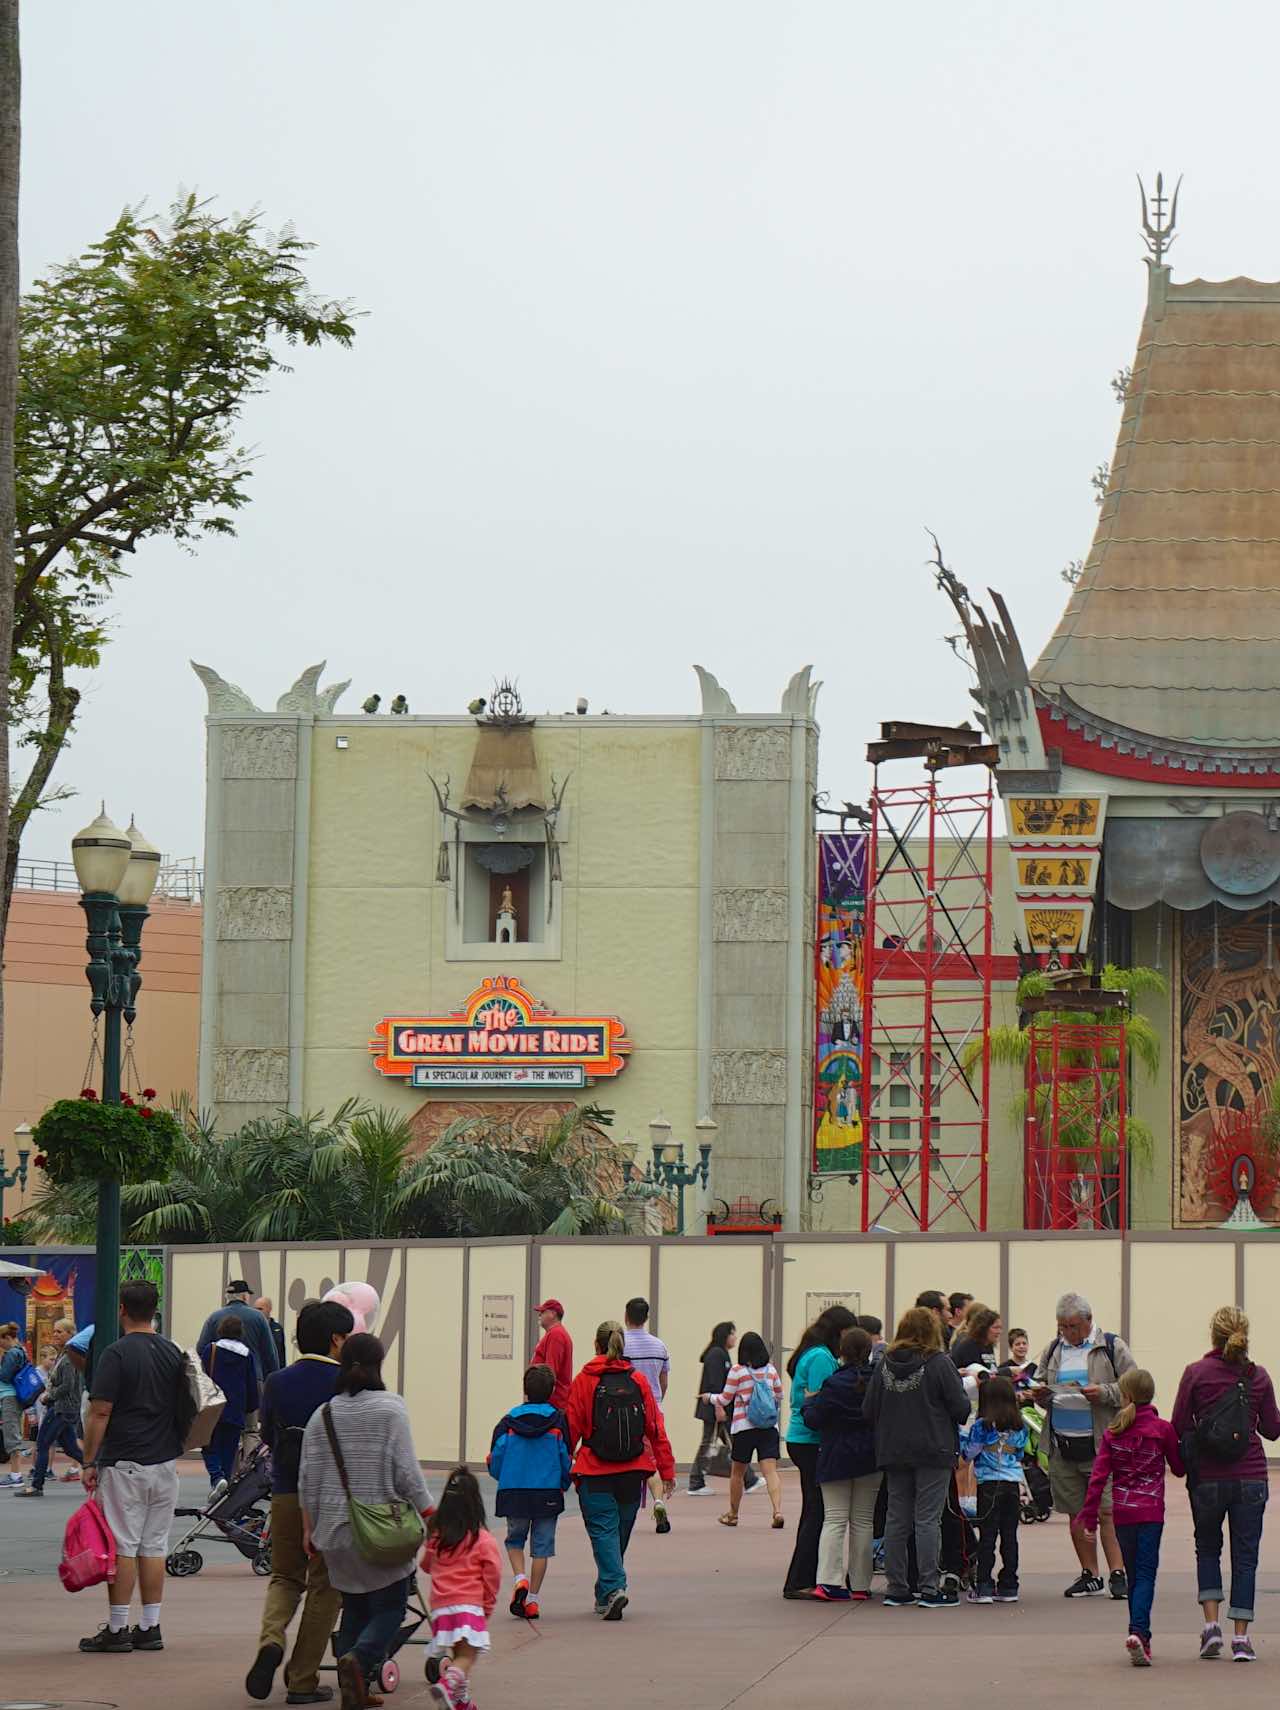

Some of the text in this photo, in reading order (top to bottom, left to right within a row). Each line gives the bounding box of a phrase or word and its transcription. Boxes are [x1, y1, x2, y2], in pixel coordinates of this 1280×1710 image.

[478, 1003, 517, 1031] The
[398, 1029, 600, 1053] GREAT MOVIE RIDE
[424, 1071, 430, 1080] A
[432, 1071, 479, 1080] SPECTACULAR
[481, 1071, 512, 1080] JOURNEY
[532, 1071, 545, 1080] THE
[548, 1071, 575, 1080] MOVIES
